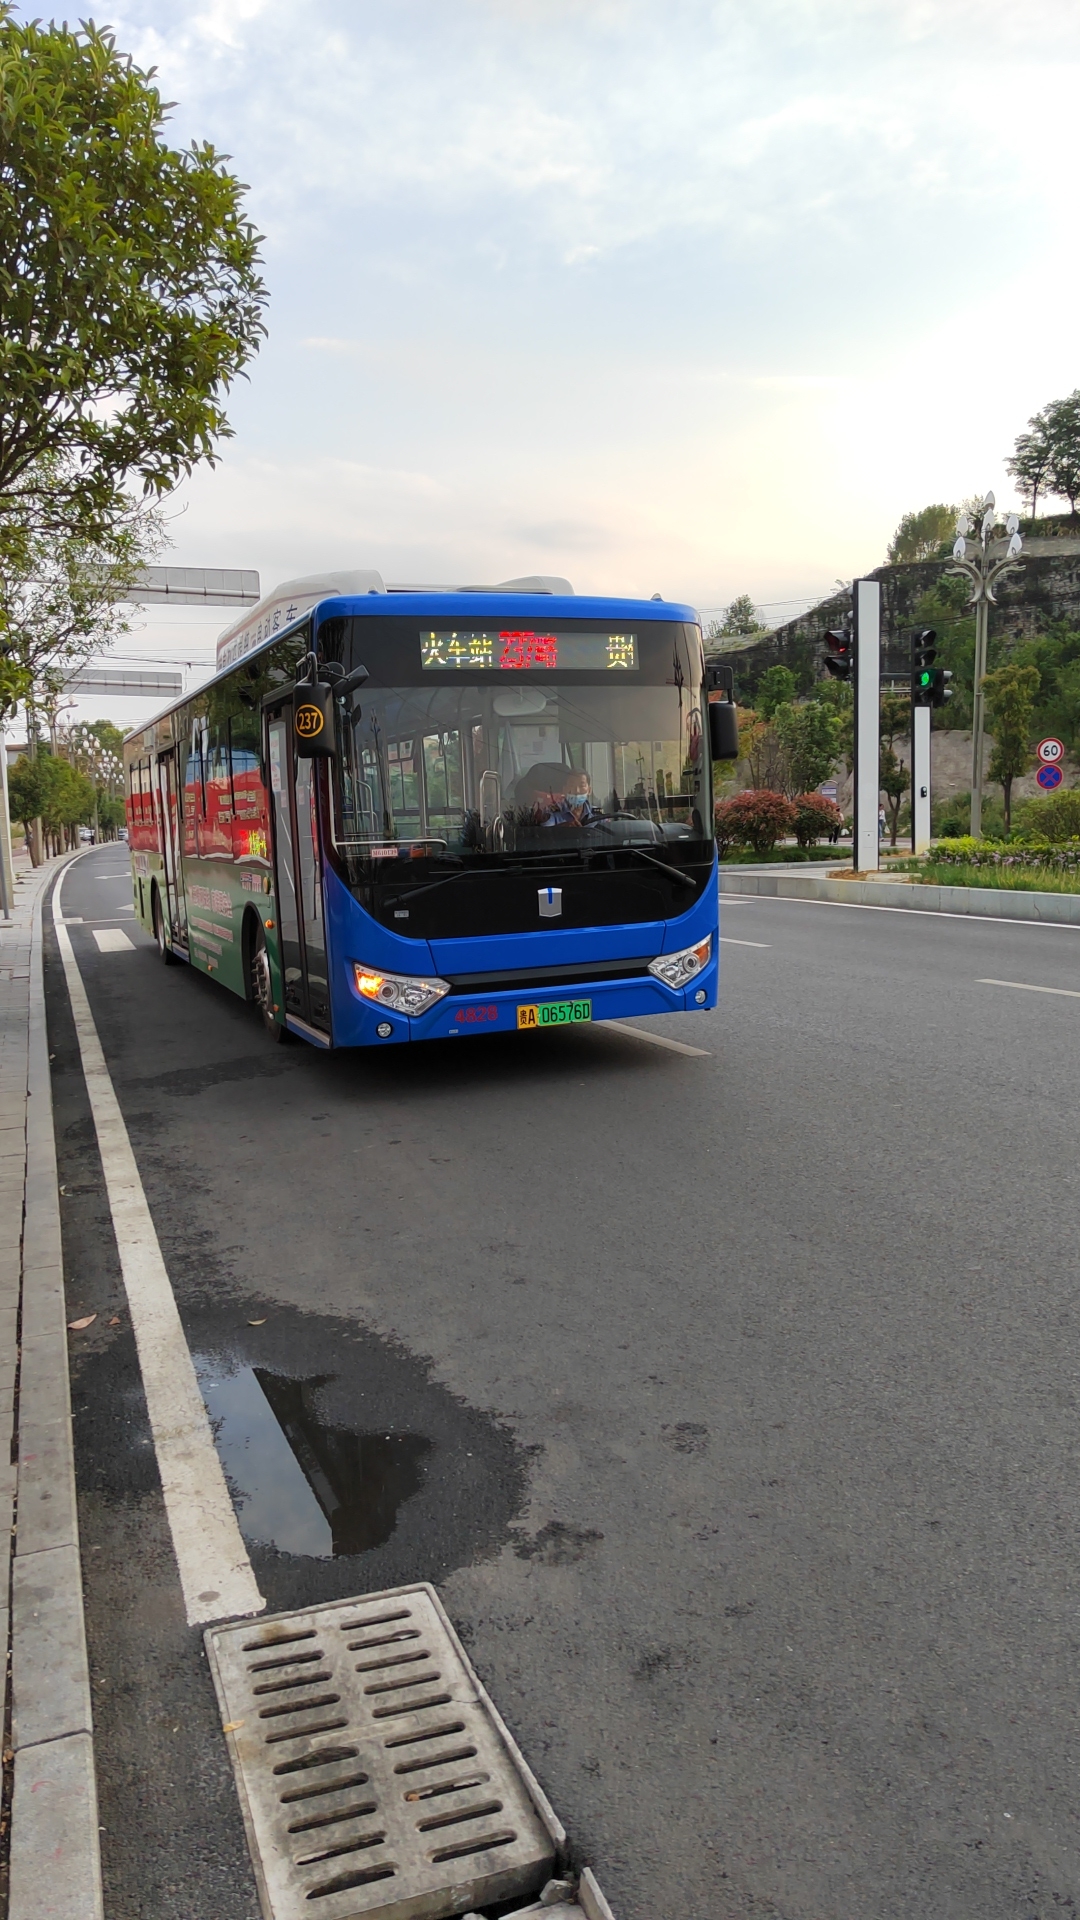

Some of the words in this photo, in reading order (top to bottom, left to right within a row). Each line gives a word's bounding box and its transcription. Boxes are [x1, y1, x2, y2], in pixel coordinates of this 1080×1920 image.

[421, 632, 492, 667] 火车站
[299, 712, 319, 730] 237
[1043, 745, 1059, 757] 60
[455, 1005, 498, 1023] 4828
